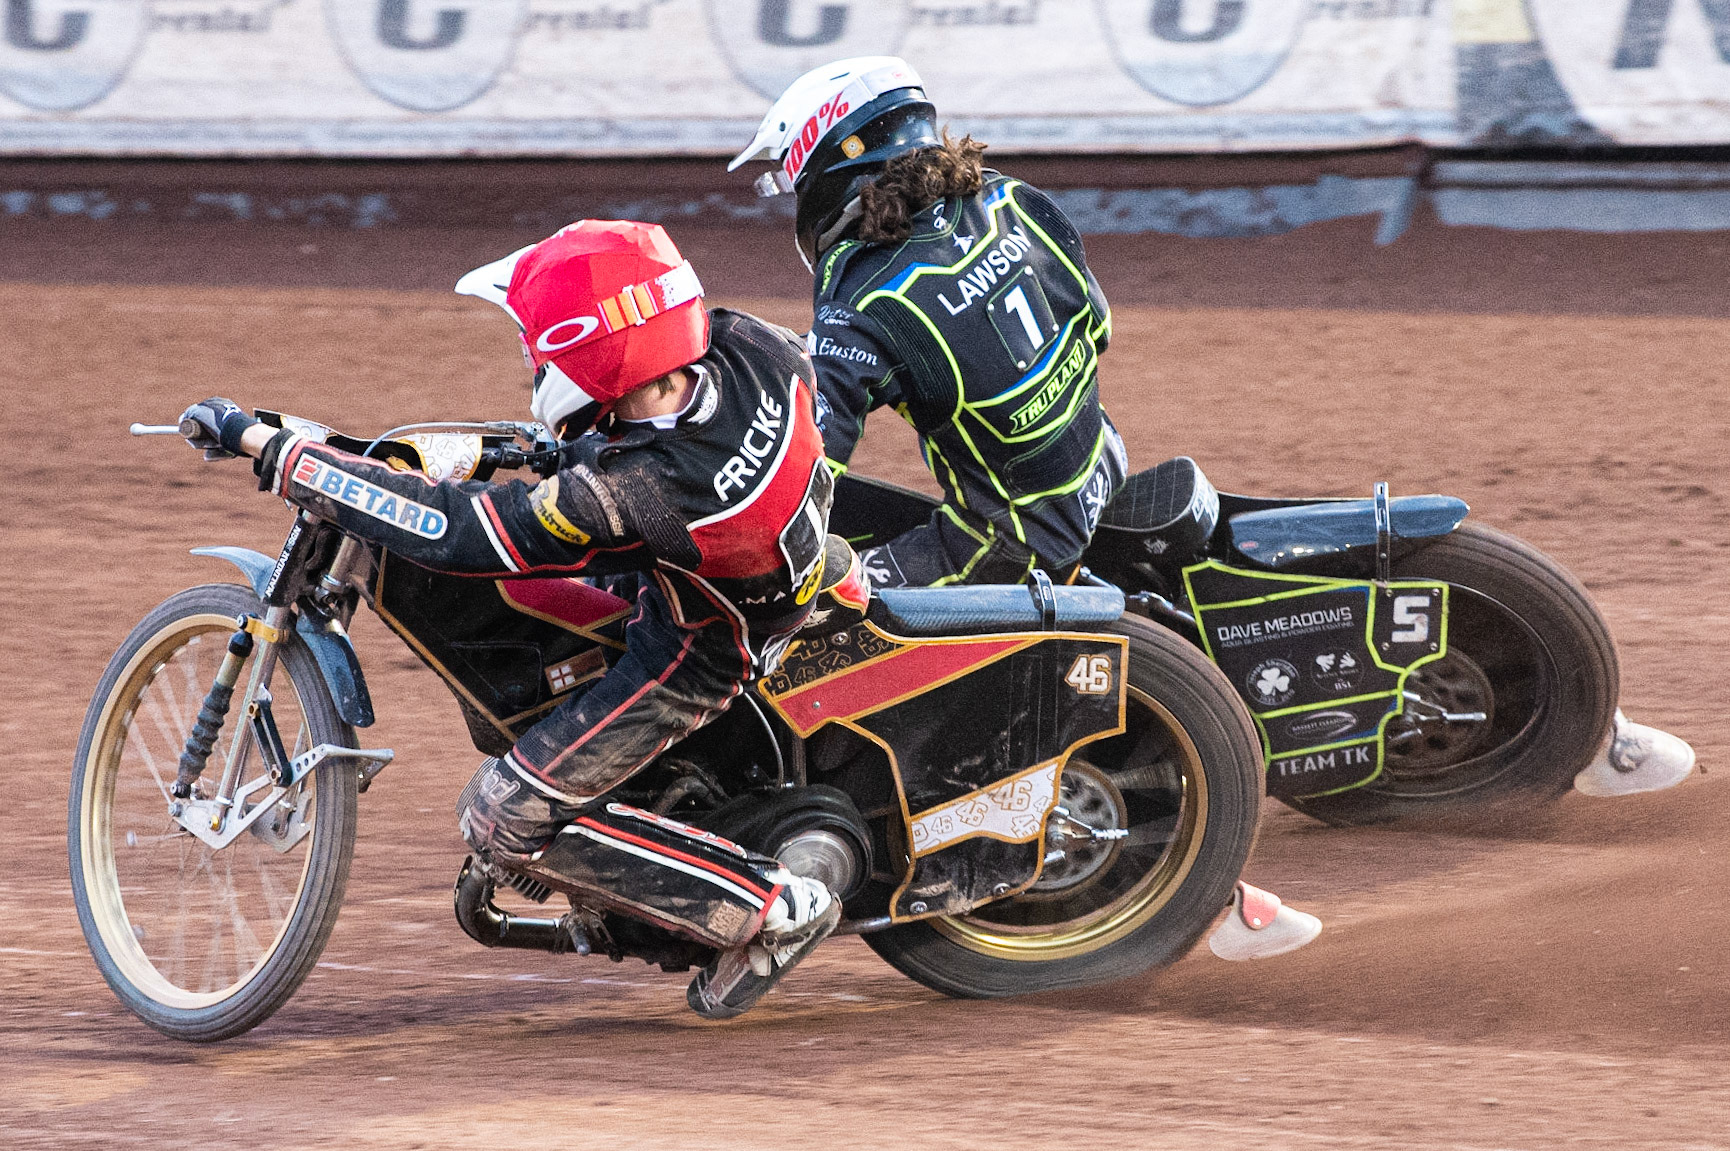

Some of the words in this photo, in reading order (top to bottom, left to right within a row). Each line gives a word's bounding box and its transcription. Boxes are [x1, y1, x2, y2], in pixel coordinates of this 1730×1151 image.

[785, 90, 849, 182] 100%
[937, 225, 1031, 316] LAWSON
[1004, 284, 1044, 350] 1
[819, 337, 878, 366] Euston
[714, 389, 782, 502] FRICKE
[320, 469, 444, 535] BETARD
[1217, 622, 1262, 641] DAVE
[1264, 606, 1353, 633] MEADOWS
[1064, 654, 1112, 695] 46
[1276, 752, 1336, 776] TEAM
[1341, 746, 1370, 765] TK
[956, 800, 988, 827] 46
[992, 780, 1033, 812] 46
[931, 815, 954, 834] 46
